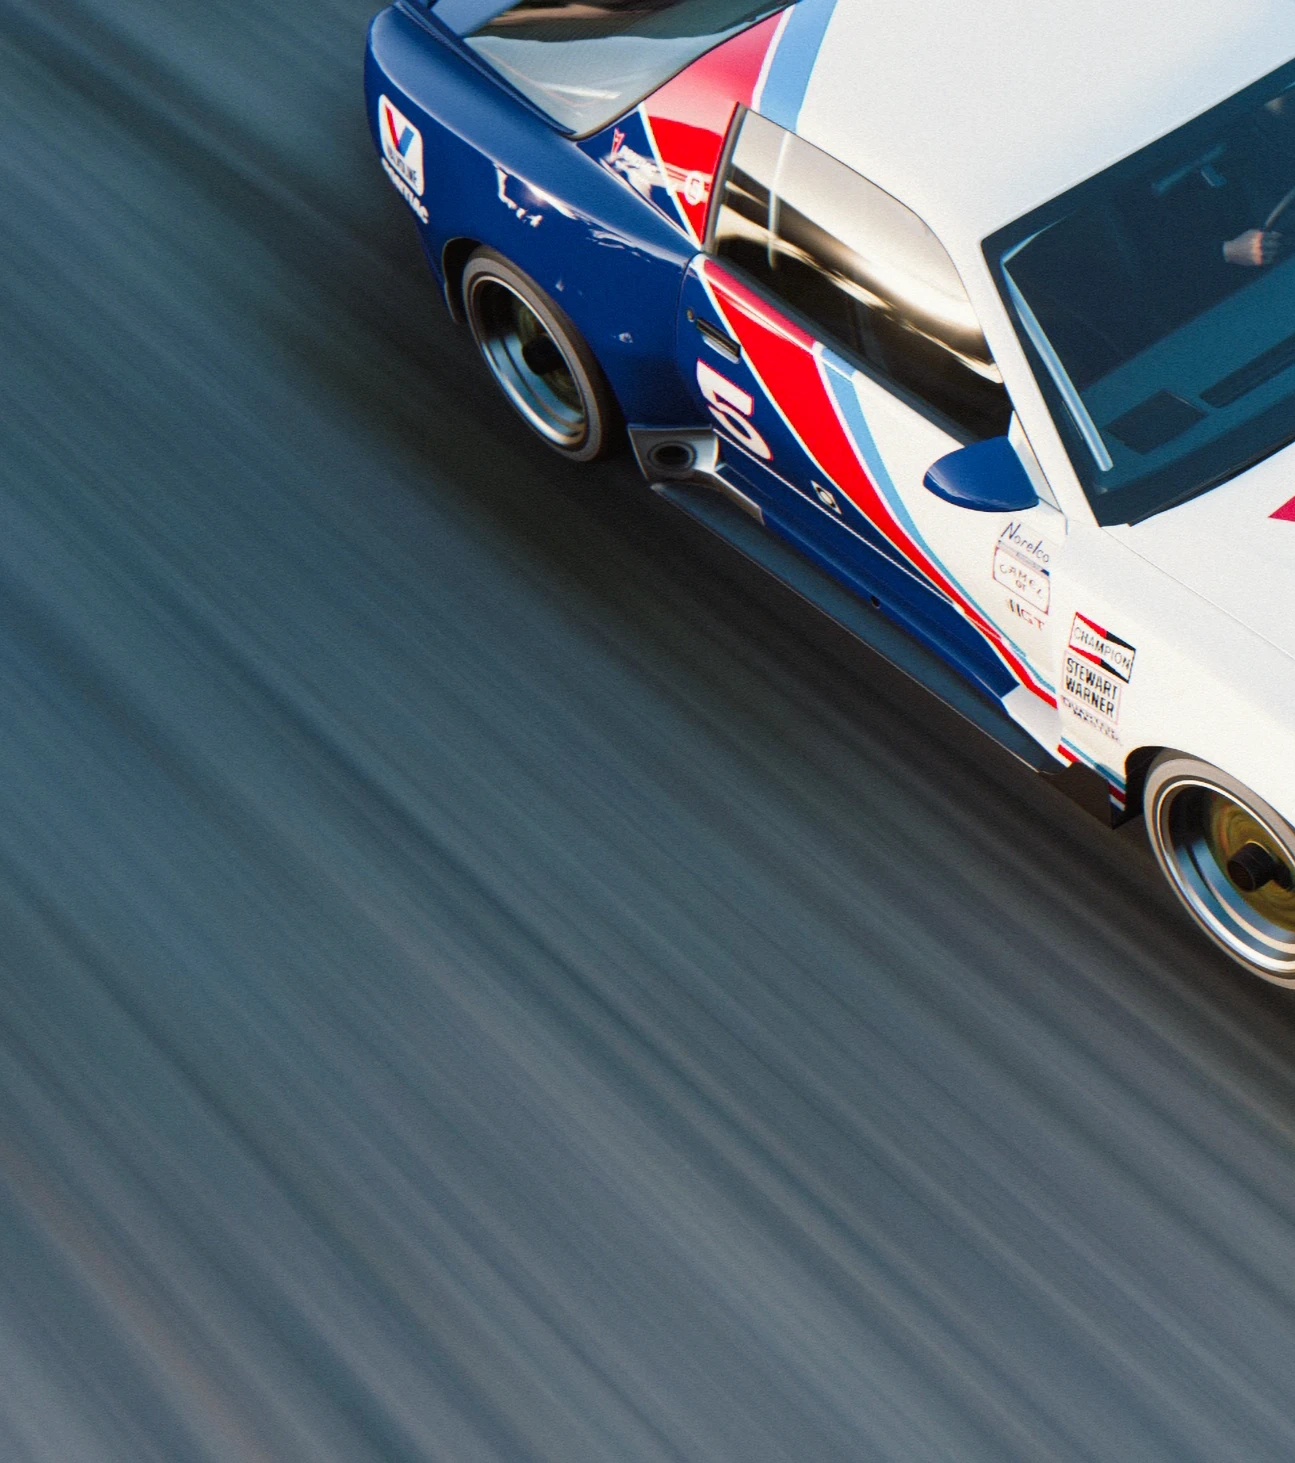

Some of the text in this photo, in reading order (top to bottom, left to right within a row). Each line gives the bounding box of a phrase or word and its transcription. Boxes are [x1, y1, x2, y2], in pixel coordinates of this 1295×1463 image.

[1000, 521, 1050, 563] Norelco
[1073, 626, 1132, 671] CHAMPION
[1065, 657, 1118, 701] STEWART
[1065, 674, 1115, 719] WARNER
